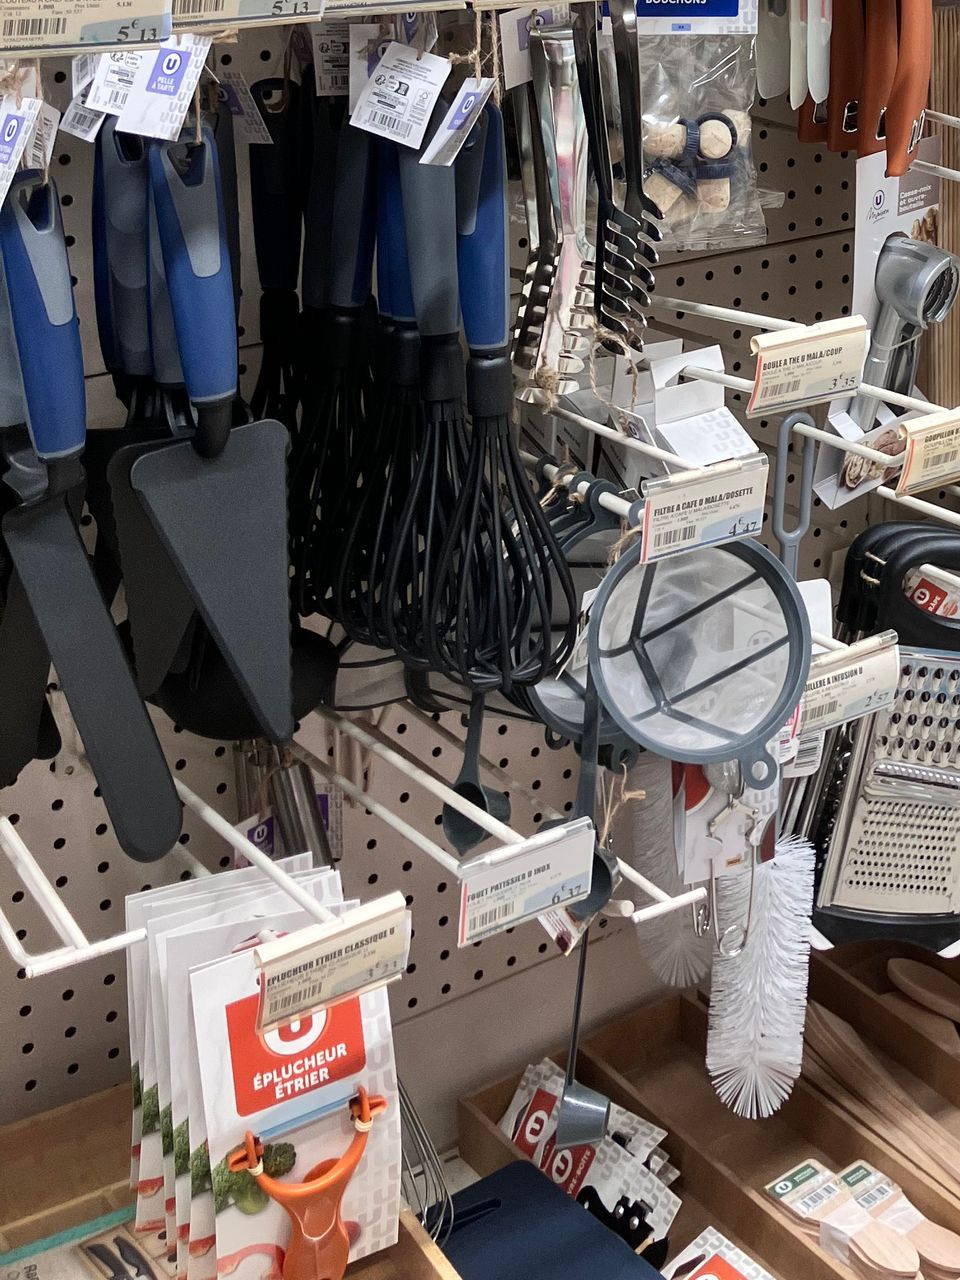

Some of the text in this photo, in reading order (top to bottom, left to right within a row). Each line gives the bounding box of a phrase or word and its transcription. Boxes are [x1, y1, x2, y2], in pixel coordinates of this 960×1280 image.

[654, 503, 675, 517] FILTRE
[467, 863, 551, 905] FOUET INOX
[267, 960, 313, 987] EPLUCHEUR
[254, 1043, 347, 1092] ÉPLUCHEUR
[274, 1069, 329, 1100] ÉTRIER
